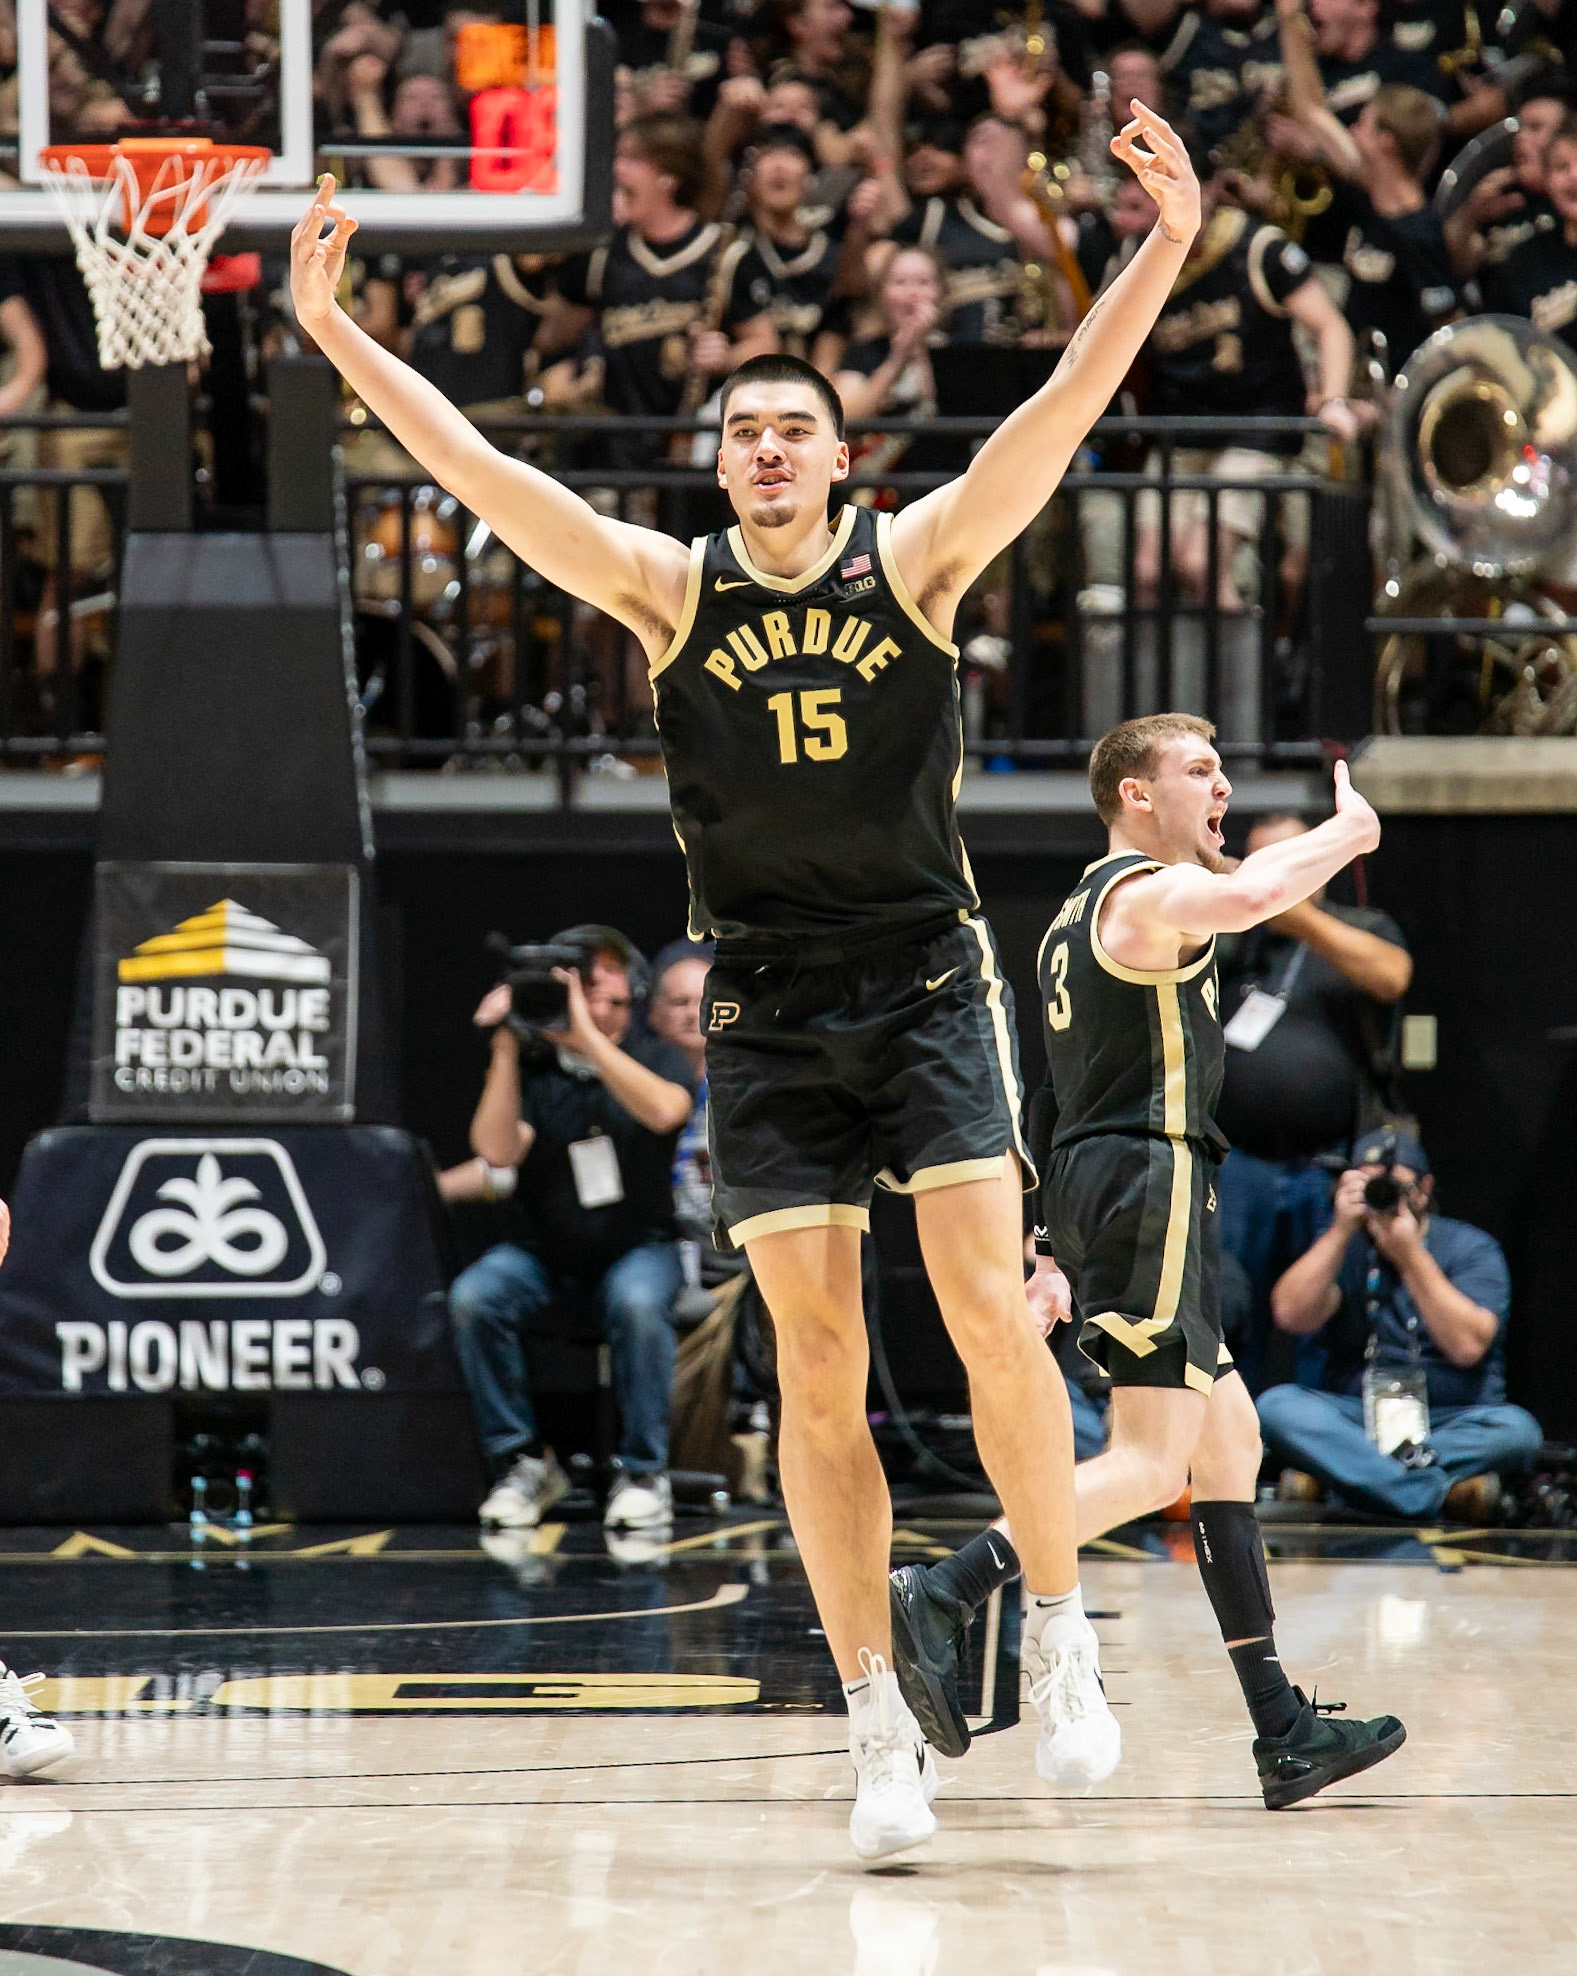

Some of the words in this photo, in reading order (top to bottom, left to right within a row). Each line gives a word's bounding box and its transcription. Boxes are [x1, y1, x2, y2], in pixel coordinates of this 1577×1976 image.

[704, 608, 902, 691] PURDUE
[768, 688, 848, 764] 15
[116, 986, 330, 1032] PURDUE
[1048, 941, 1072, 1031] 3
[708, 1002, 740, 1031] P
[115, 1028, 329, 1070] FEDERAL
[115, 1067, 217, 1093] CREDIT
[230, 1068, 329, 1094] UNION
